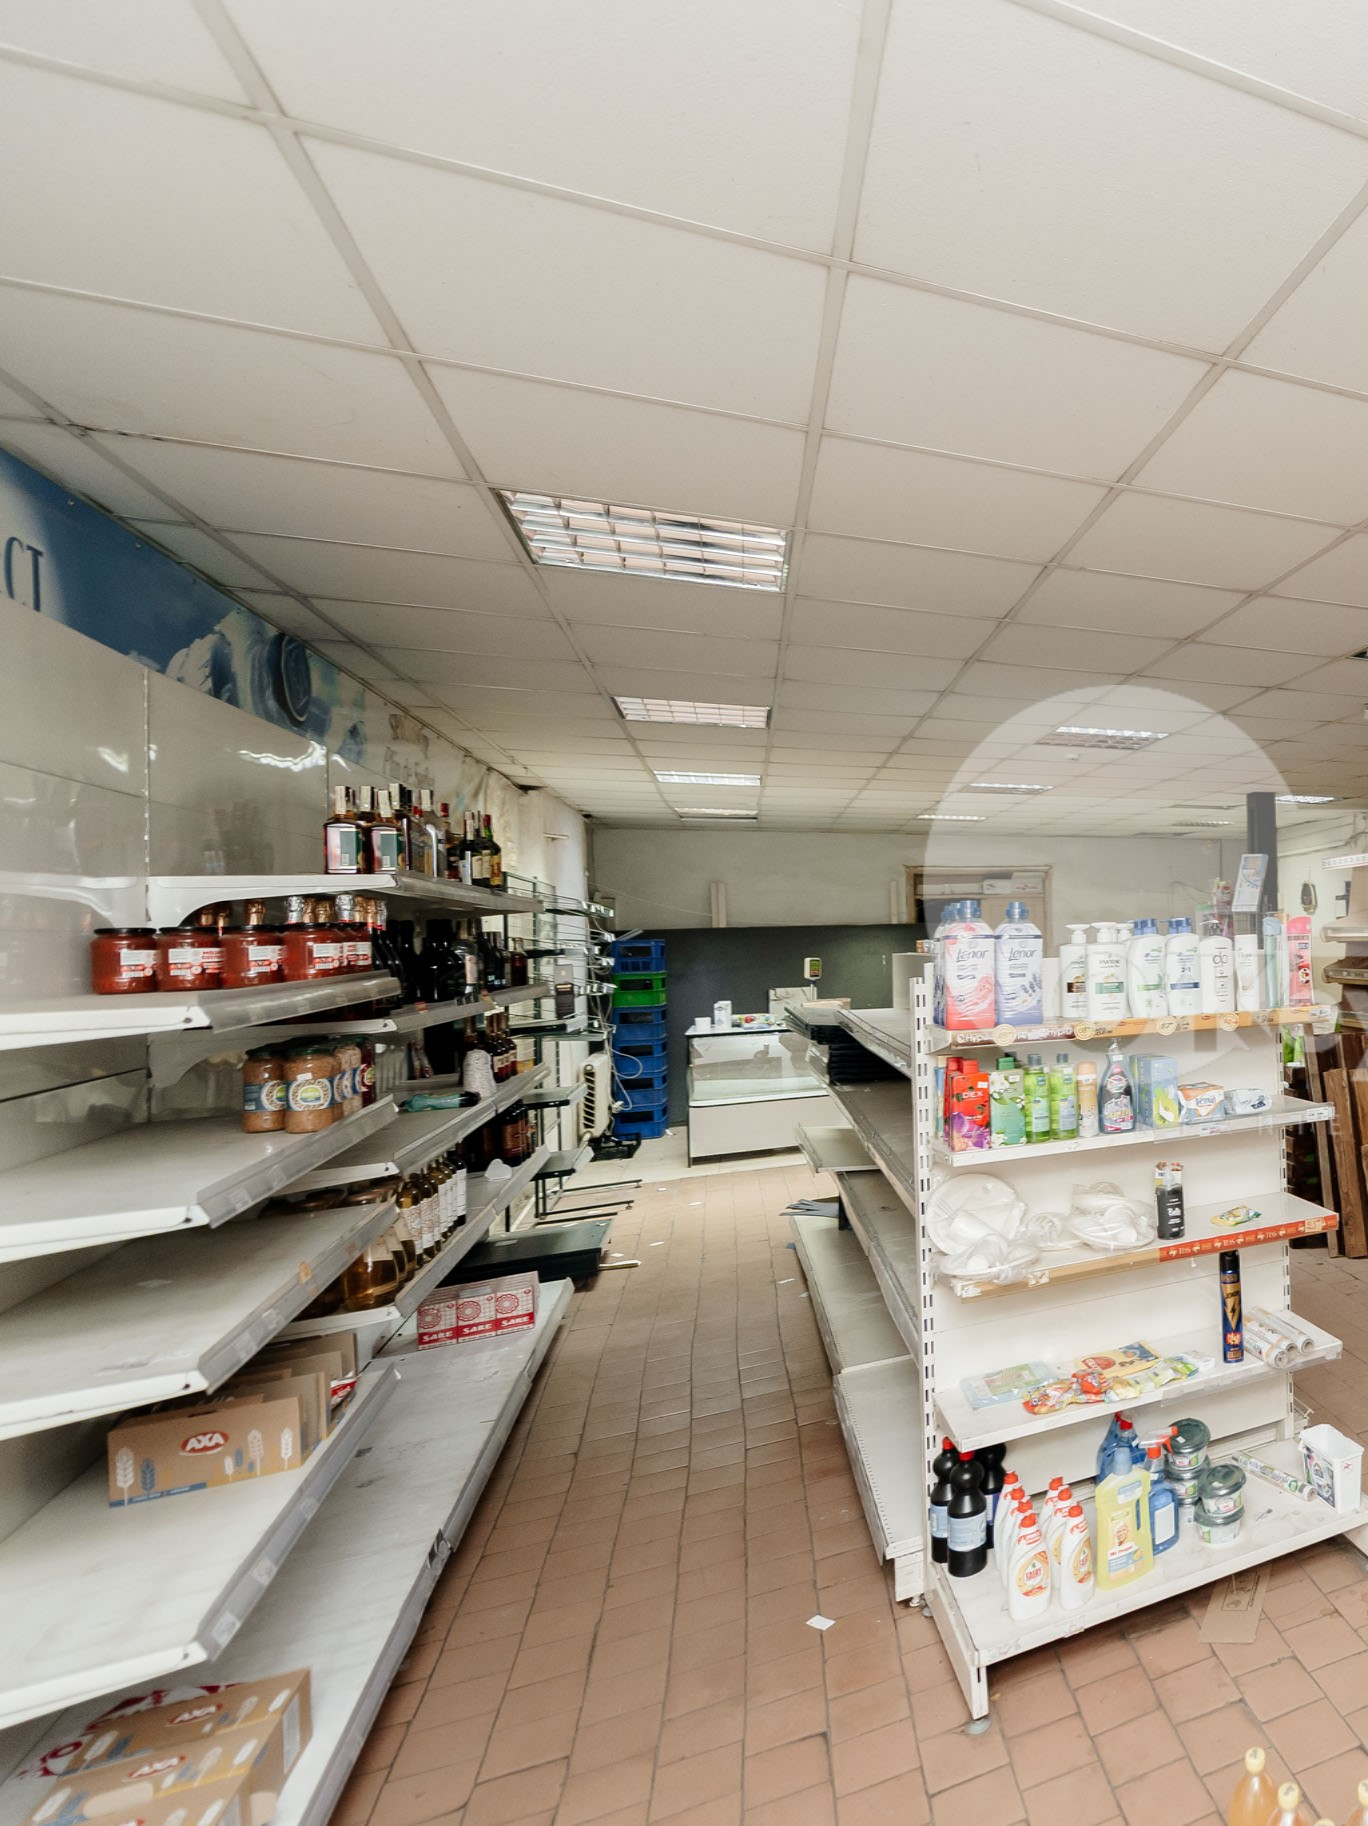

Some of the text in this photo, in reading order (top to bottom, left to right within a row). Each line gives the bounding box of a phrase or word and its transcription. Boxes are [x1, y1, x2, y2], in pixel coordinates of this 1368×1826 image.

[956, 947, 989, 962] Lenor
[1008, 947, 1037, 961] Lenor
[962, 1091, 984, 1099] DEX
[501, 1316, 530, 1327] SARE
[463, 1323, 493, 1335] SARE
[422, 1330, 453, 1342] SARE
[185, 1431, 226, 1451] AXA
